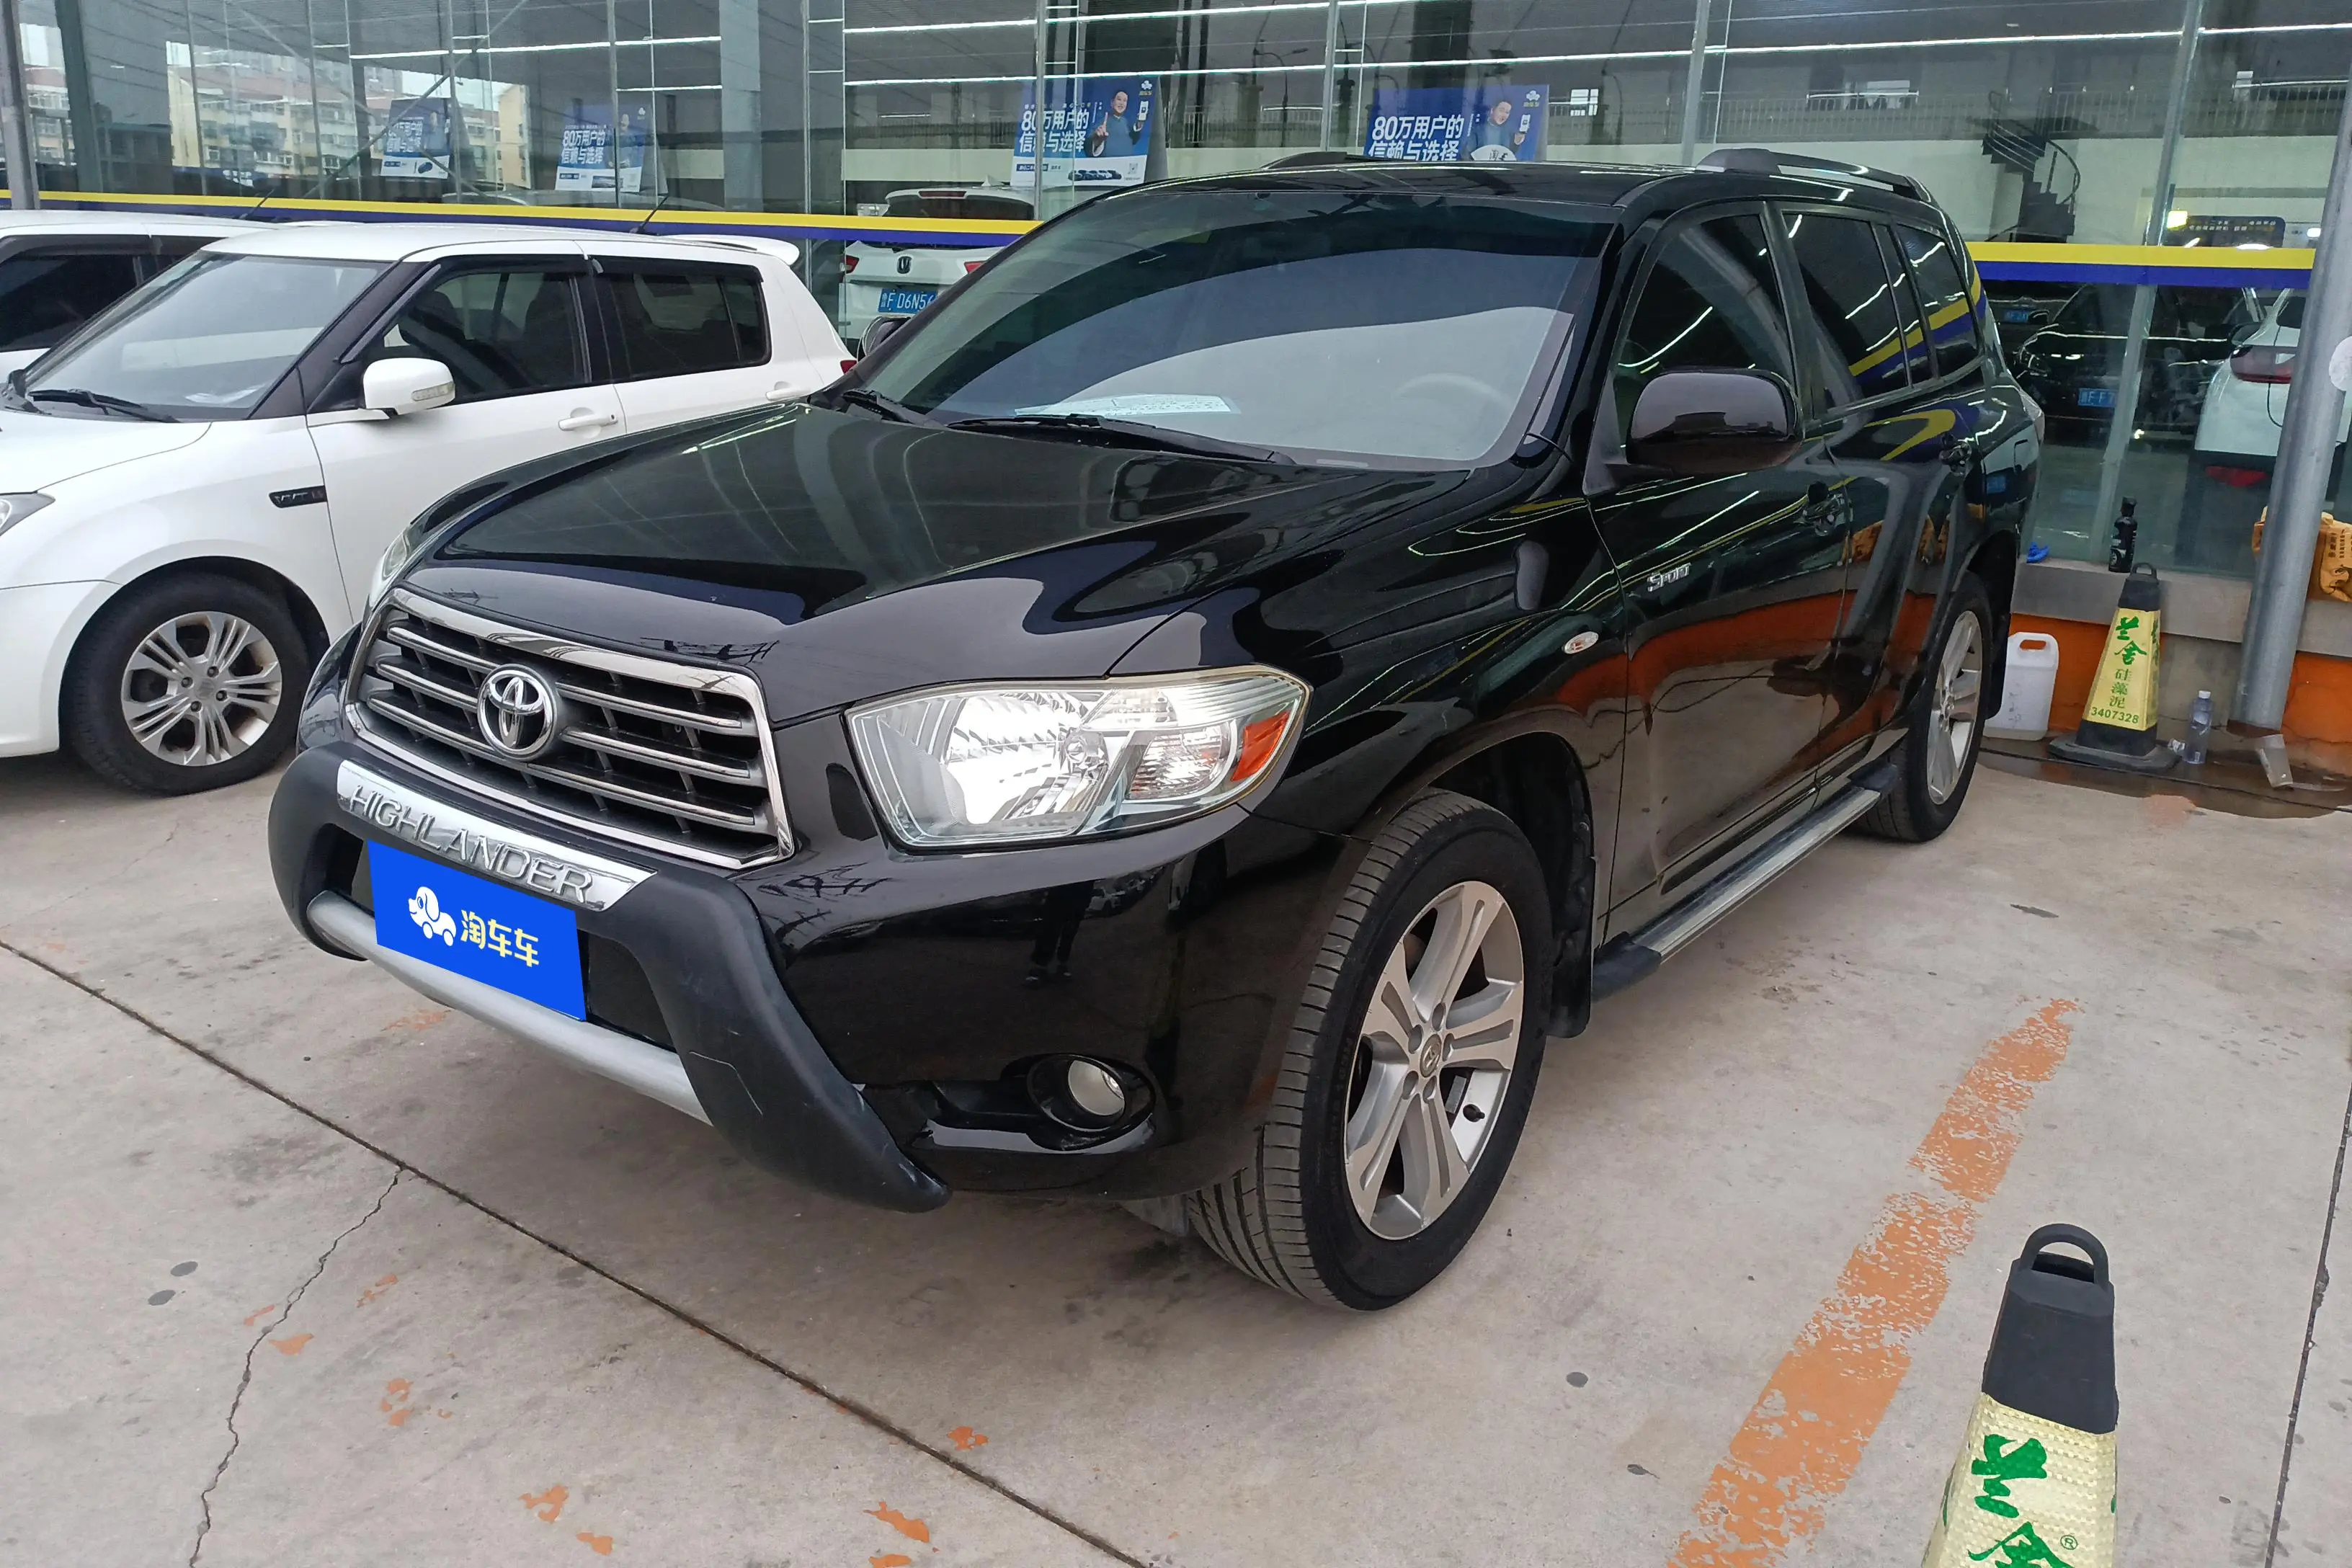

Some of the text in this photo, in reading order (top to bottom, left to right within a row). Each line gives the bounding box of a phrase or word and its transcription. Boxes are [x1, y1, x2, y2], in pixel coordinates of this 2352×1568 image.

[562, 129, 606, 147] 80万用户的
[1372, 115, 1464, 140] 80万用户的
[1019, 130, 1087, 153] 信与选择
[1368, 140, 1459, 161] 信赖与选择
[2109, 668, 2132, 708] 硅藻泥
[2091, 706, 2139, 724] 3407328
[349, 785, 594, 905] HIGHLANDER
